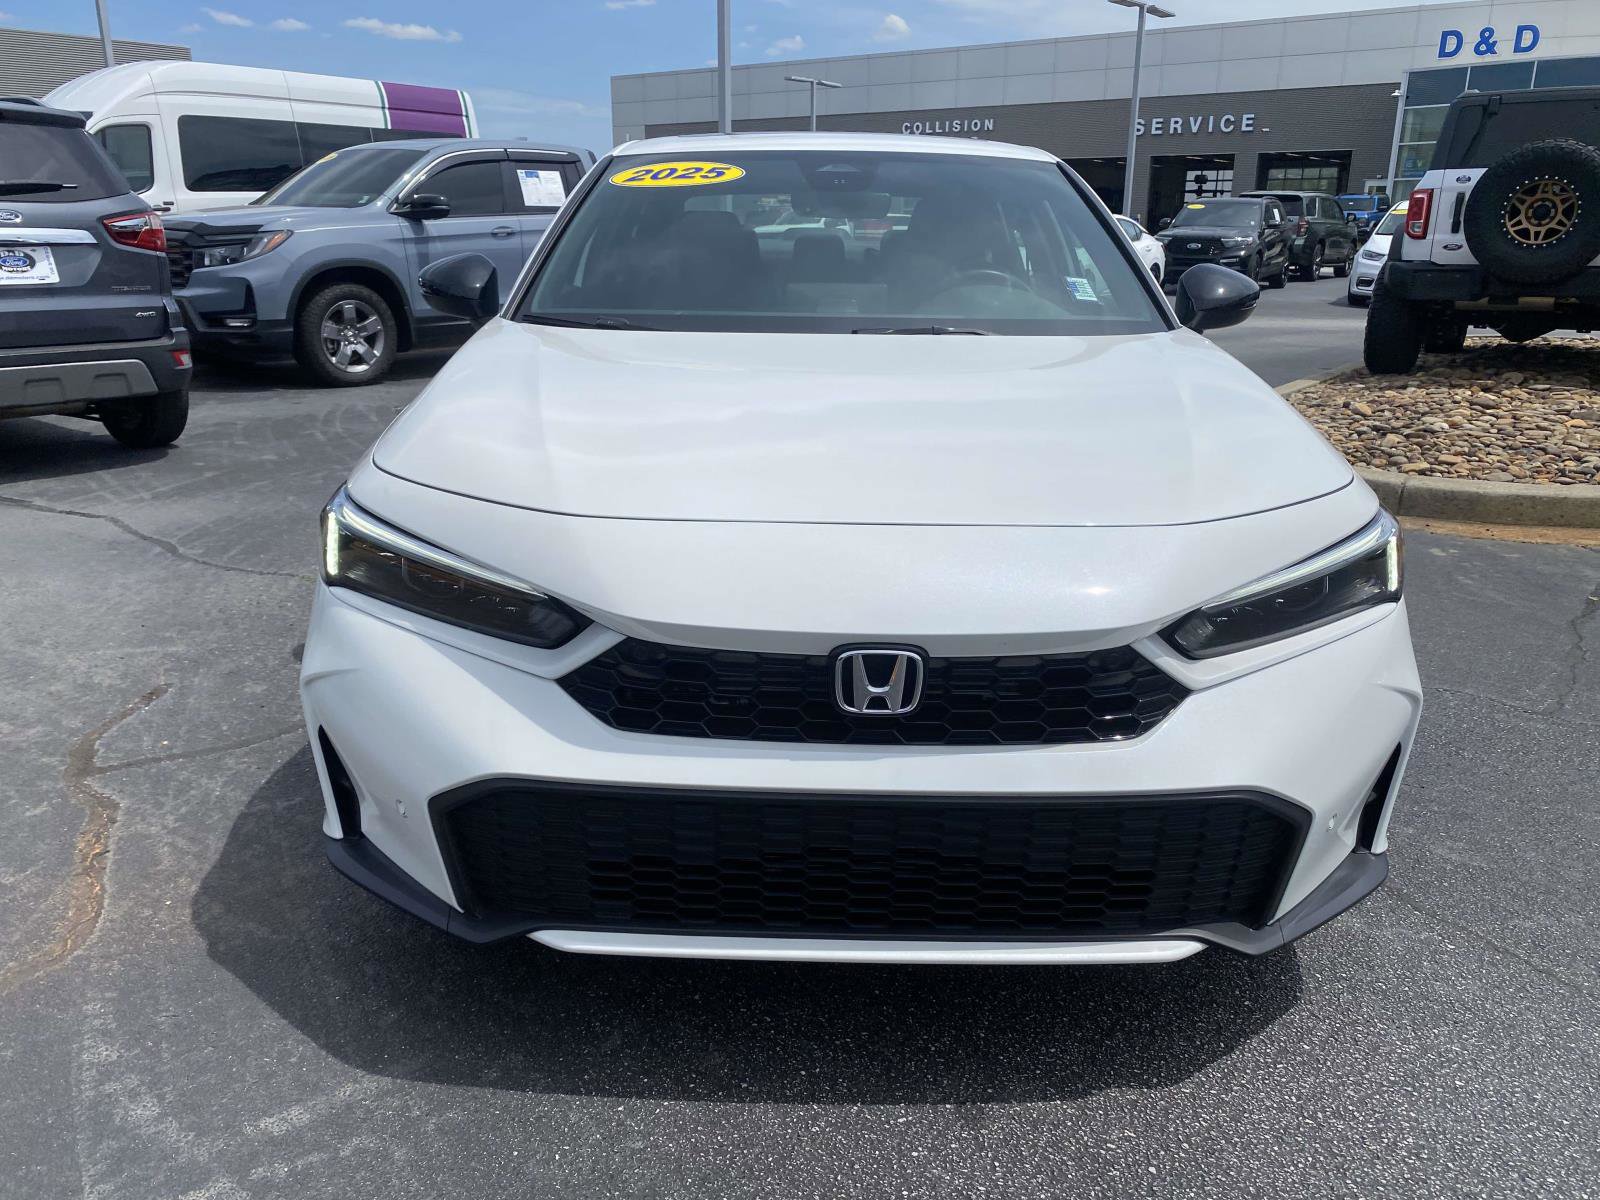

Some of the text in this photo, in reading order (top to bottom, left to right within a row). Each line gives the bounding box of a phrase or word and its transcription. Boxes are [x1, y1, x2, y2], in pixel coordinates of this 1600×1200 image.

[1438, 24, 1541, 59] D & D
[901, 118, 995, 135] COLLISION
[1135, 113, 1256, 136] SERVICE
[621, 166, 733, 183] 2025
